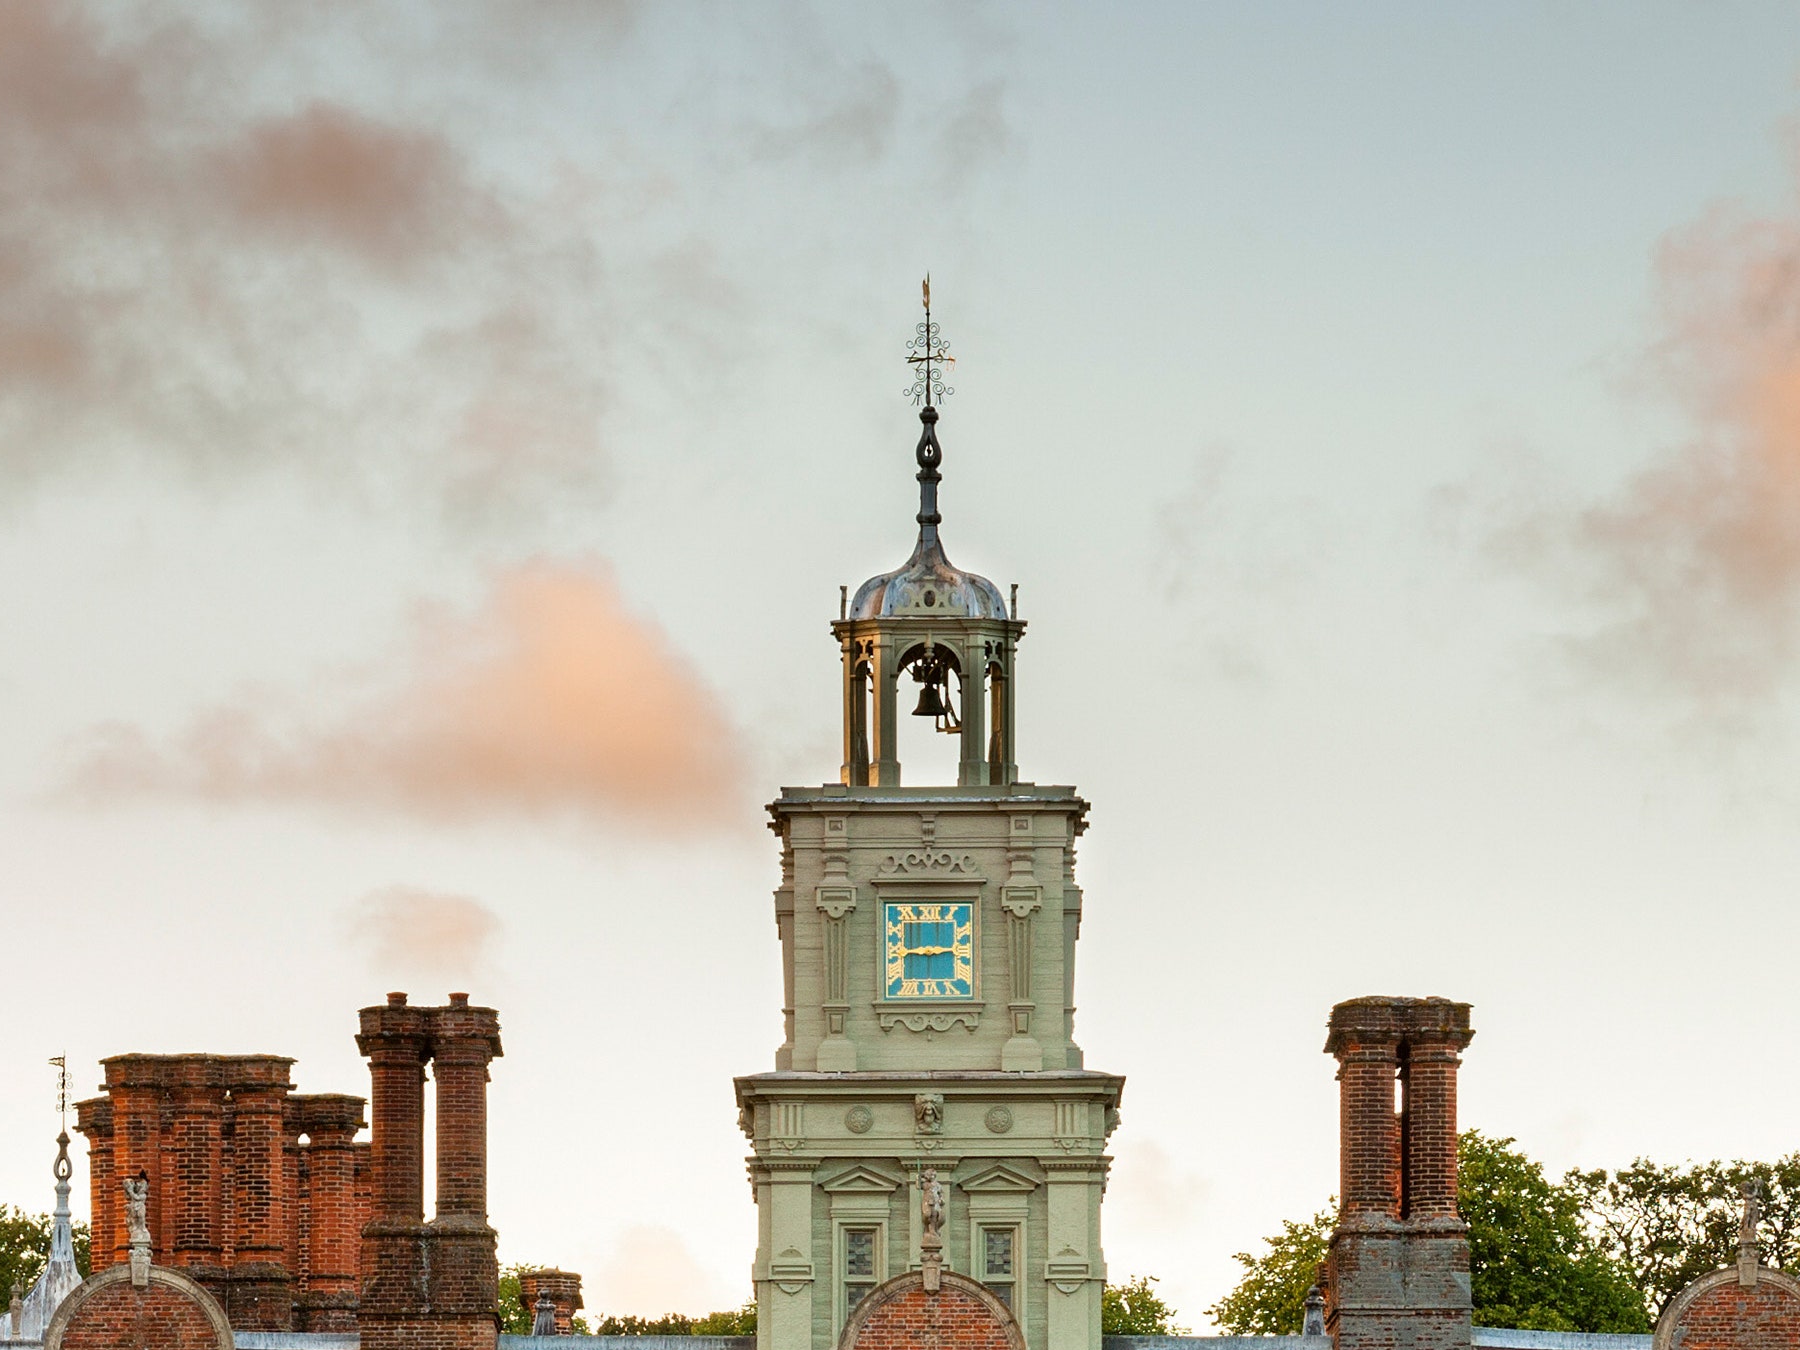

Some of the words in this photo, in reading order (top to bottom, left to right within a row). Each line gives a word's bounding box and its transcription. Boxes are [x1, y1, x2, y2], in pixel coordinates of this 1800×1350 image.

[897, 906, 916, 920] XI
[919, 906, 941, 920] XII
[945, 906, 958, 920] I
[888, 921, 903, 938] X
[957, 921, 970, 940] II
[956, 942, 970, 959] III
[897, 981, 919, 995] VII
[923, 981, 941, 995] VI
[943, 981, 960, 995] V
